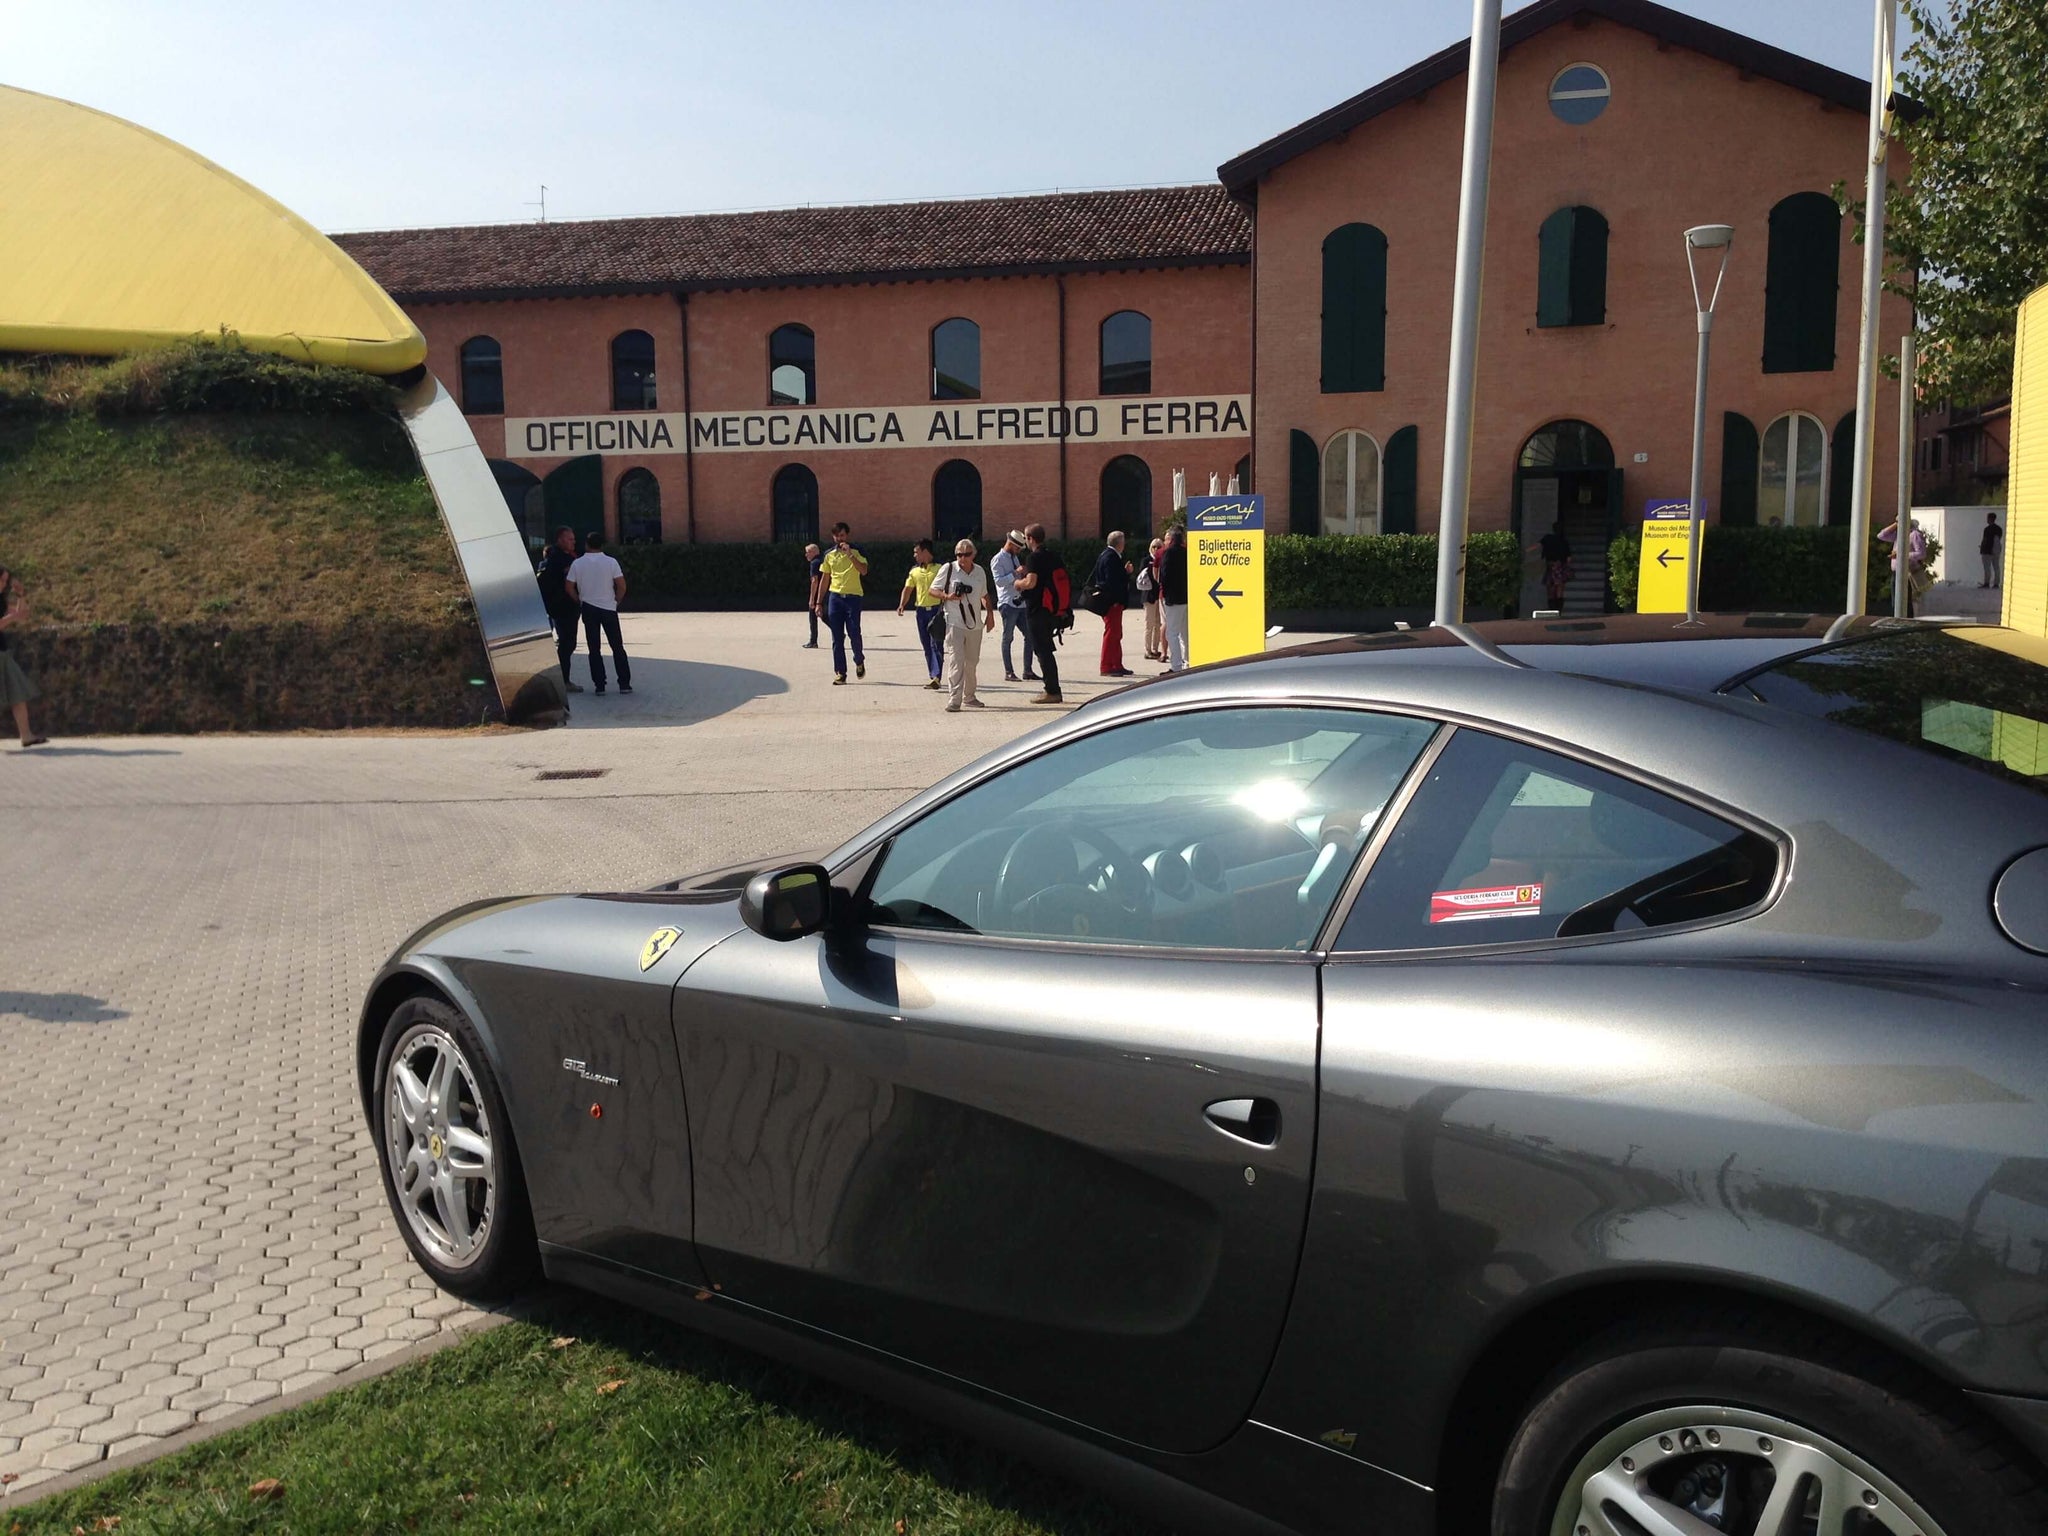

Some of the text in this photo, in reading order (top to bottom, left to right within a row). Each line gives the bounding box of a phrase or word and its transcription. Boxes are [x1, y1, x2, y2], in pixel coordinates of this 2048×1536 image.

[526, 400, 1248, 451] OFFICINA MECCANICA ALFREDO FERRA
[1199, 540, 1251, 554] Biglietteria
[1200, 553, 1250, 566] Box Office
